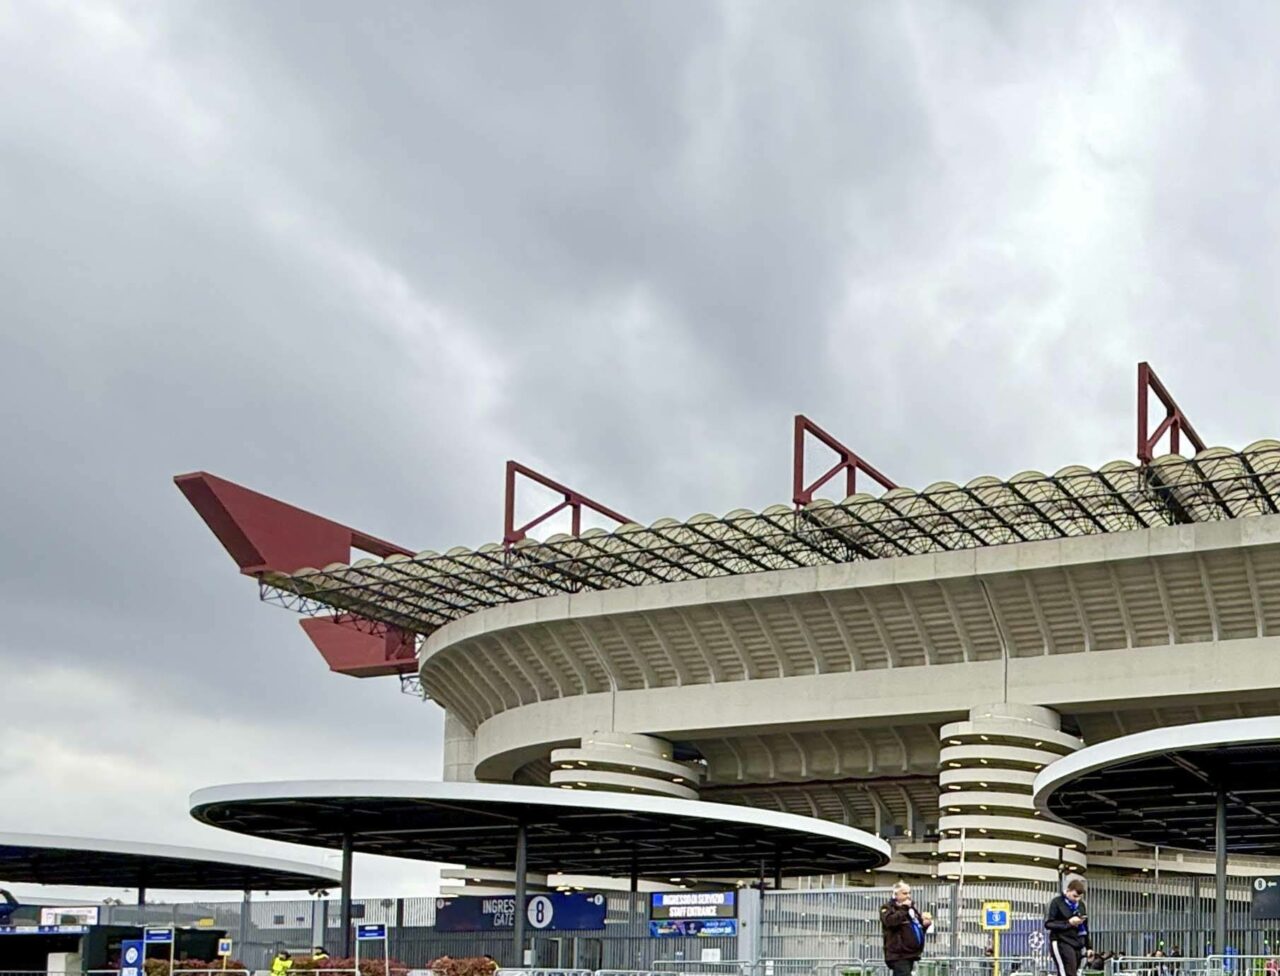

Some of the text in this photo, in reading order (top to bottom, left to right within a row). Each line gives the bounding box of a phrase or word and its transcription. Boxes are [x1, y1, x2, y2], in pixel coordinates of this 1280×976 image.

[482, 899, 516, 914] INGRES
[535, 900, 545, 924] 8
[493, 913, 515, 927] GATE
